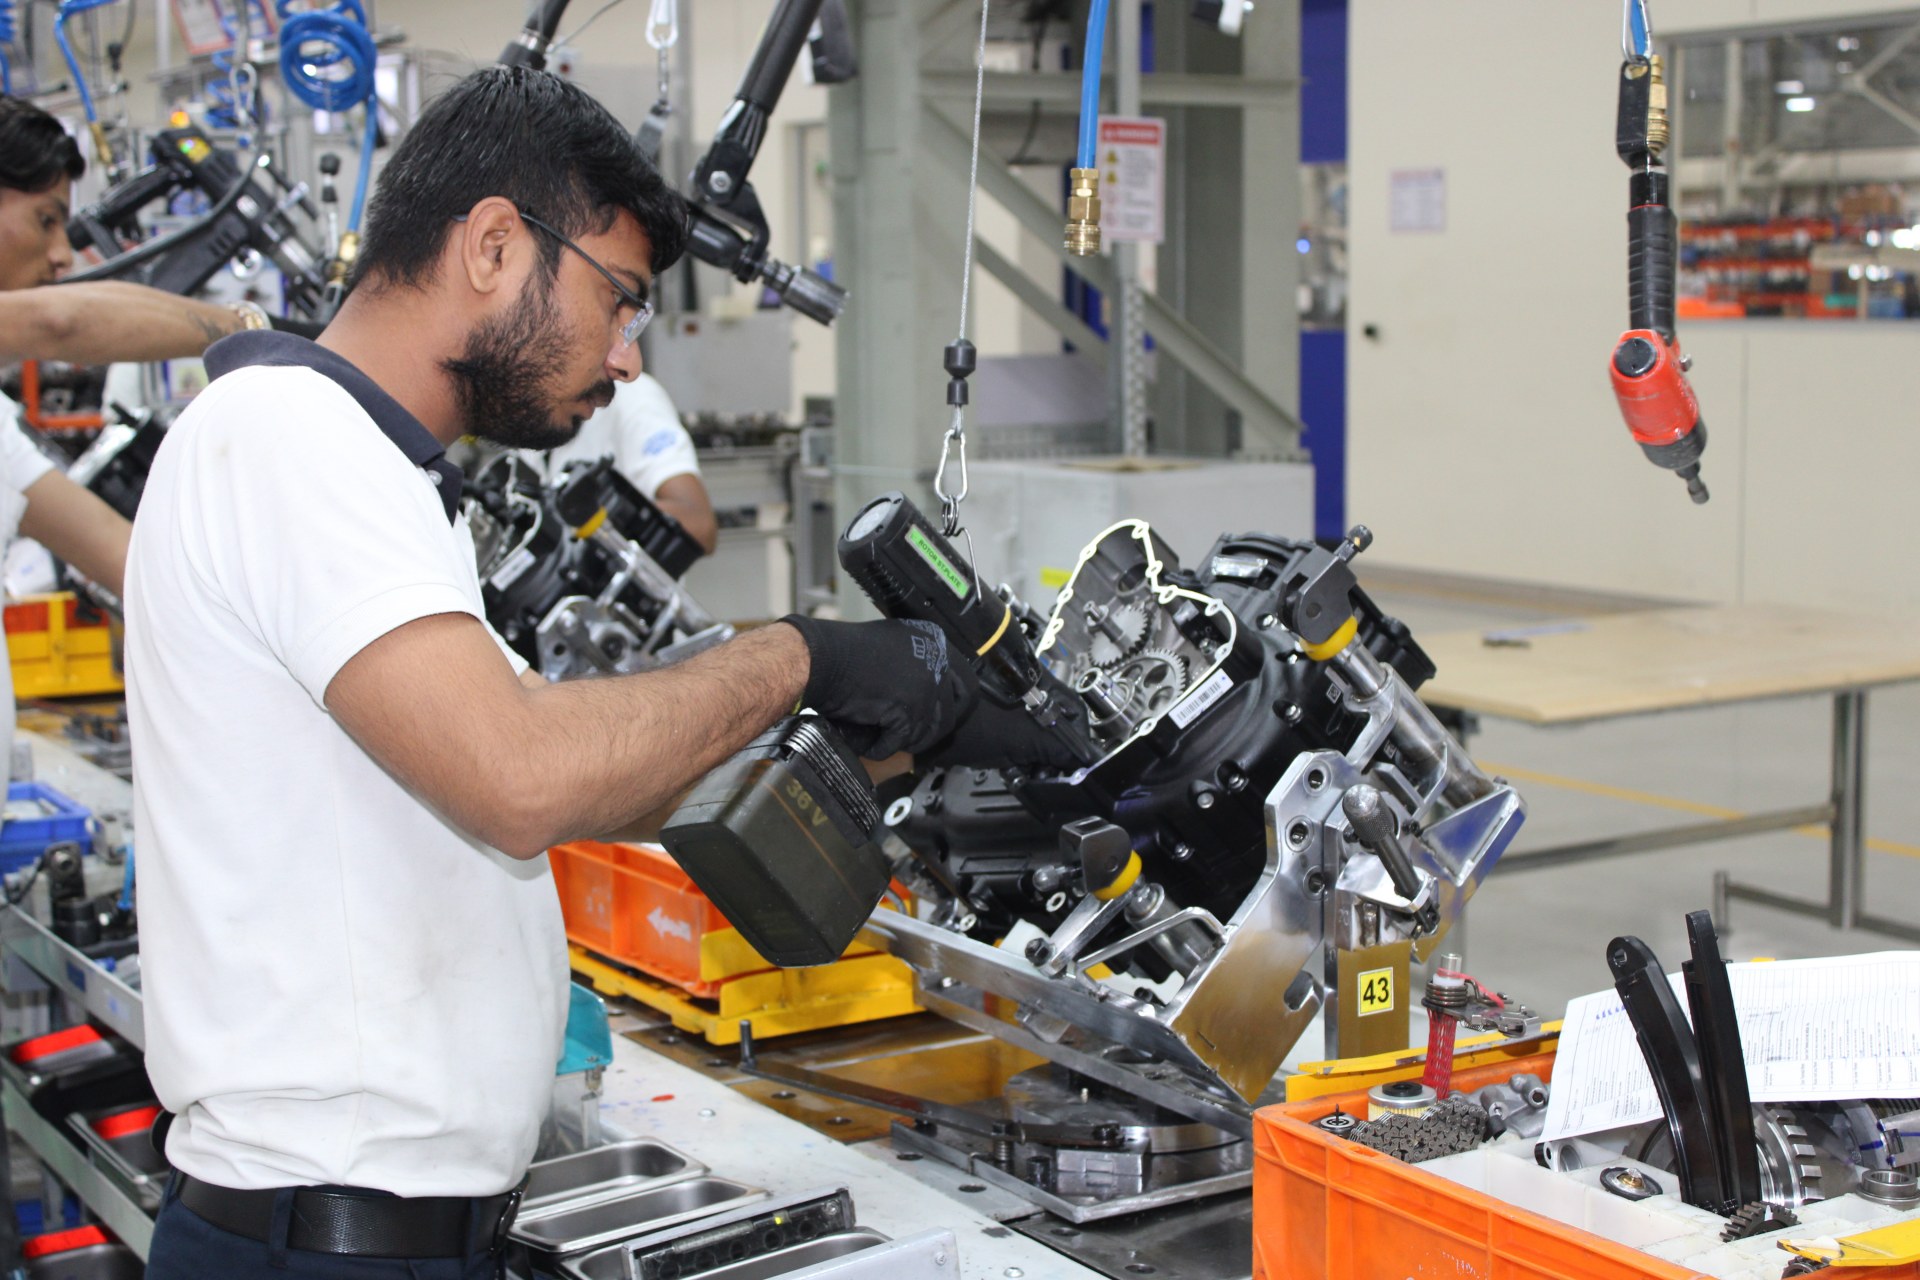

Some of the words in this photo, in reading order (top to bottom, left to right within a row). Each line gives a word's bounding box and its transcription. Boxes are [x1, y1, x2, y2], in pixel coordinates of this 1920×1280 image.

[918, 540, 938, 561] ROTOR
[786, 778, 813, 810] 36
[812, 805, 829, 827] V
[1363, 977, 1390, 1005] 43
